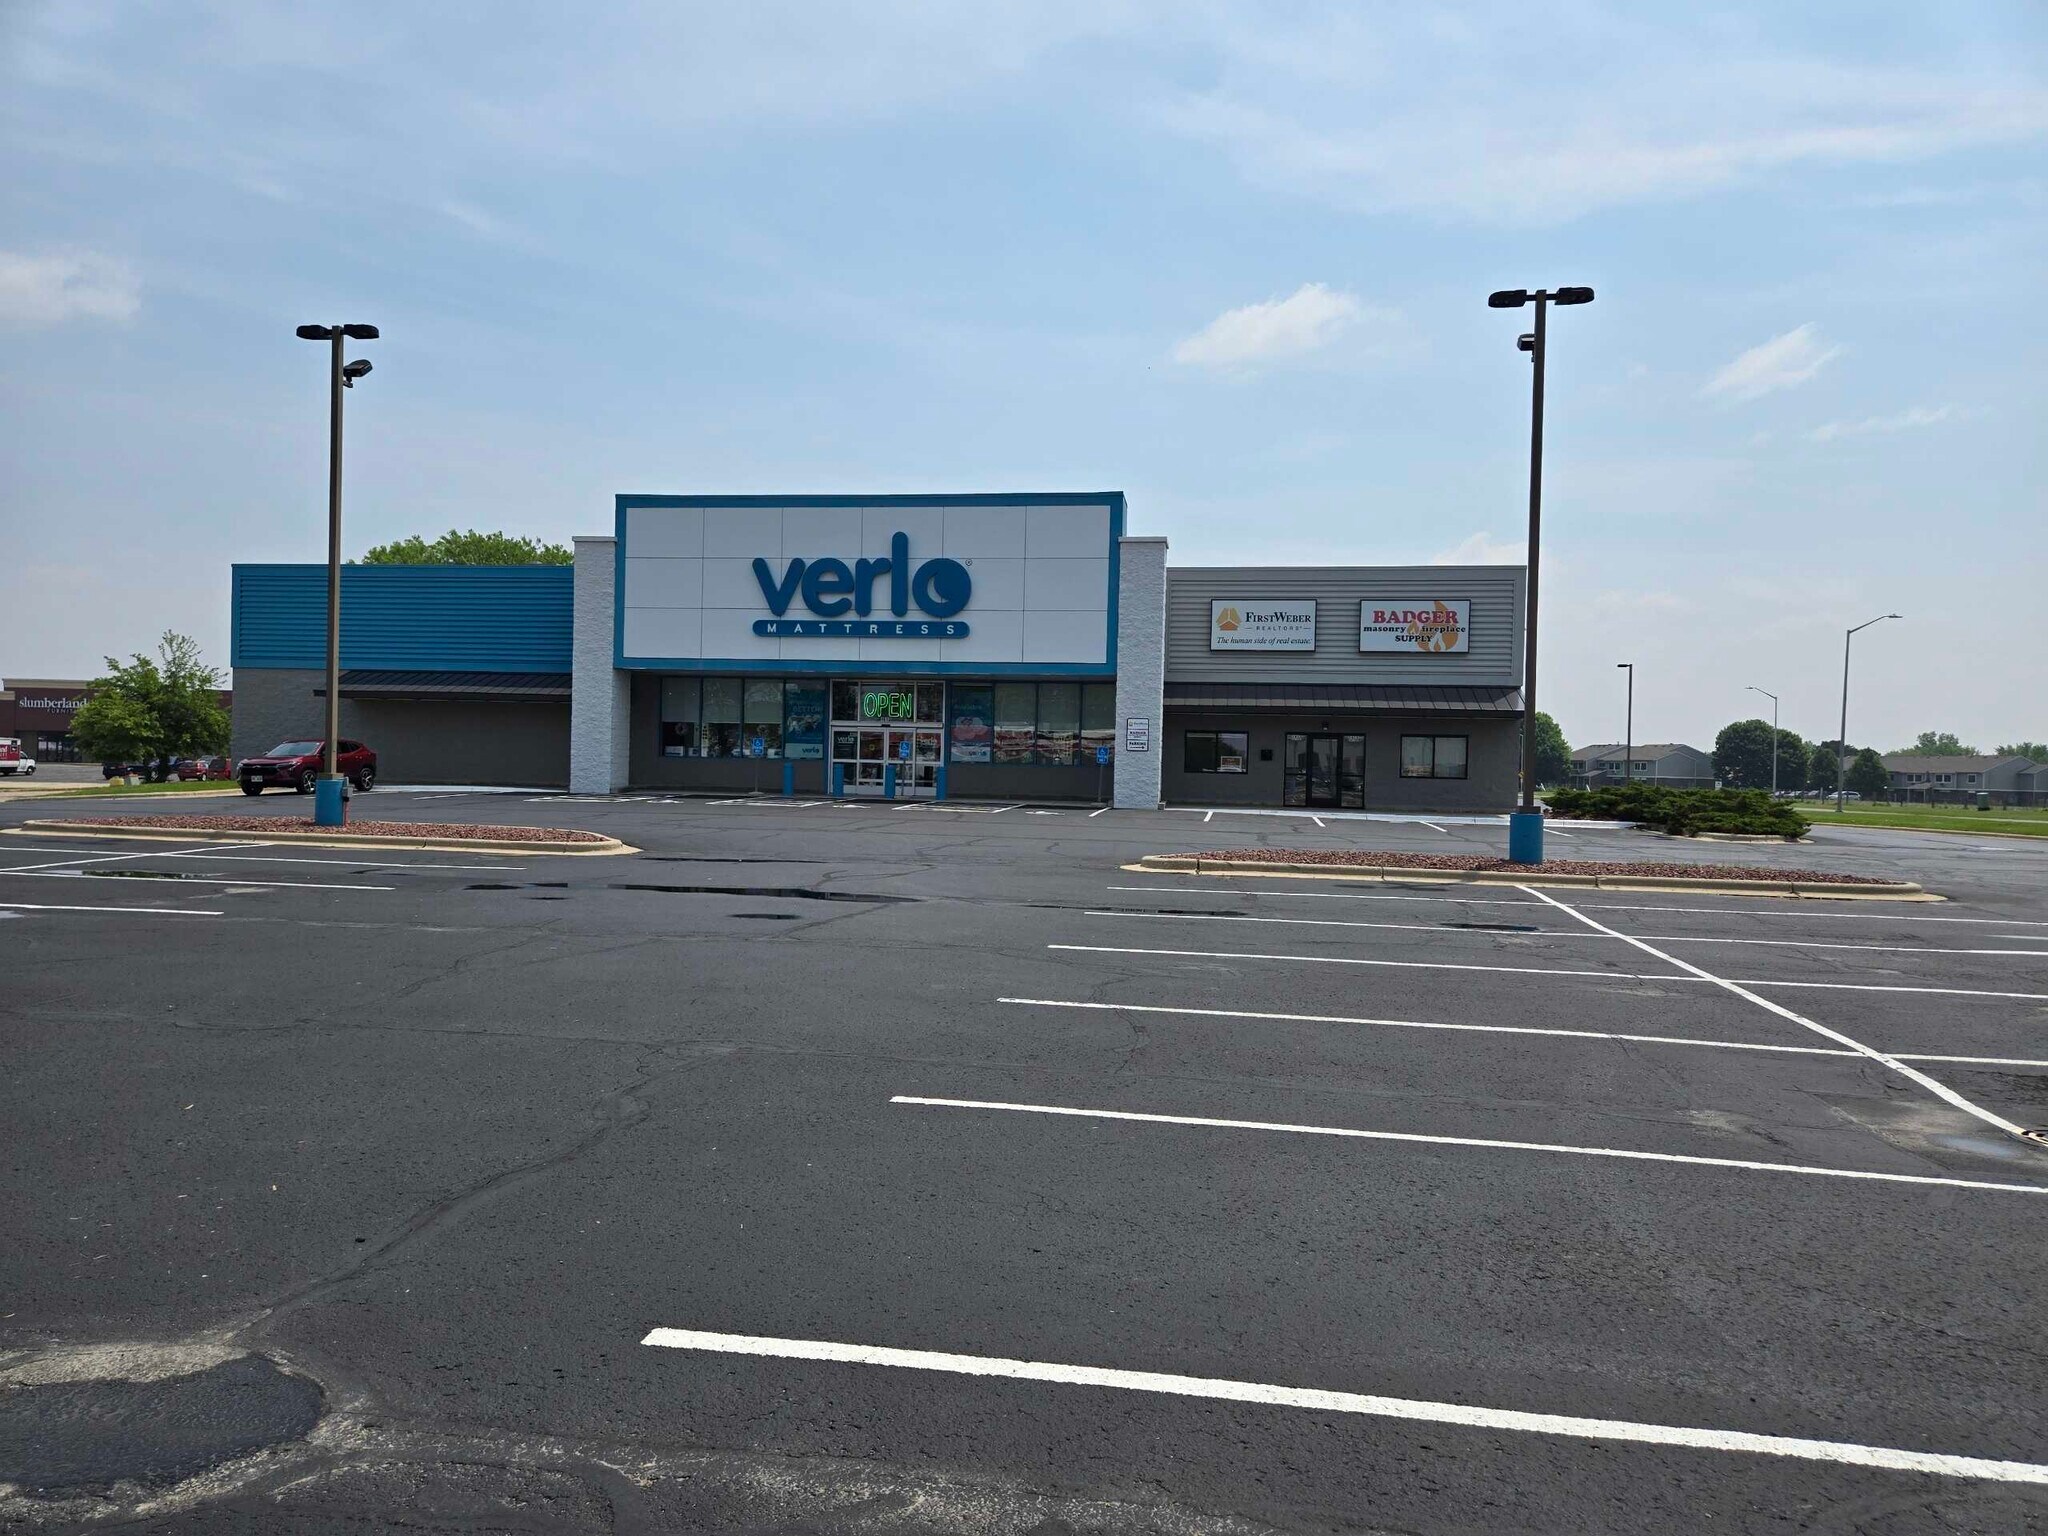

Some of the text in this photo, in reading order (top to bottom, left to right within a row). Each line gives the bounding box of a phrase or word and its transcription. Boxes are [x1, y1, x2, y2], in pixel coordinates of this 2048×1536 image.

[752, 531, 972, 618] verlo
[1373, 610, 1459, 624] BADGER
[767, 624, 955, 635] MATTRESS
[1421, 625, 1466, 634] fireplace
[1268, 637, 1276, 646] of
[20, 697, 87, 709] slumberland
[863, 692, 912, 718] OPEN
